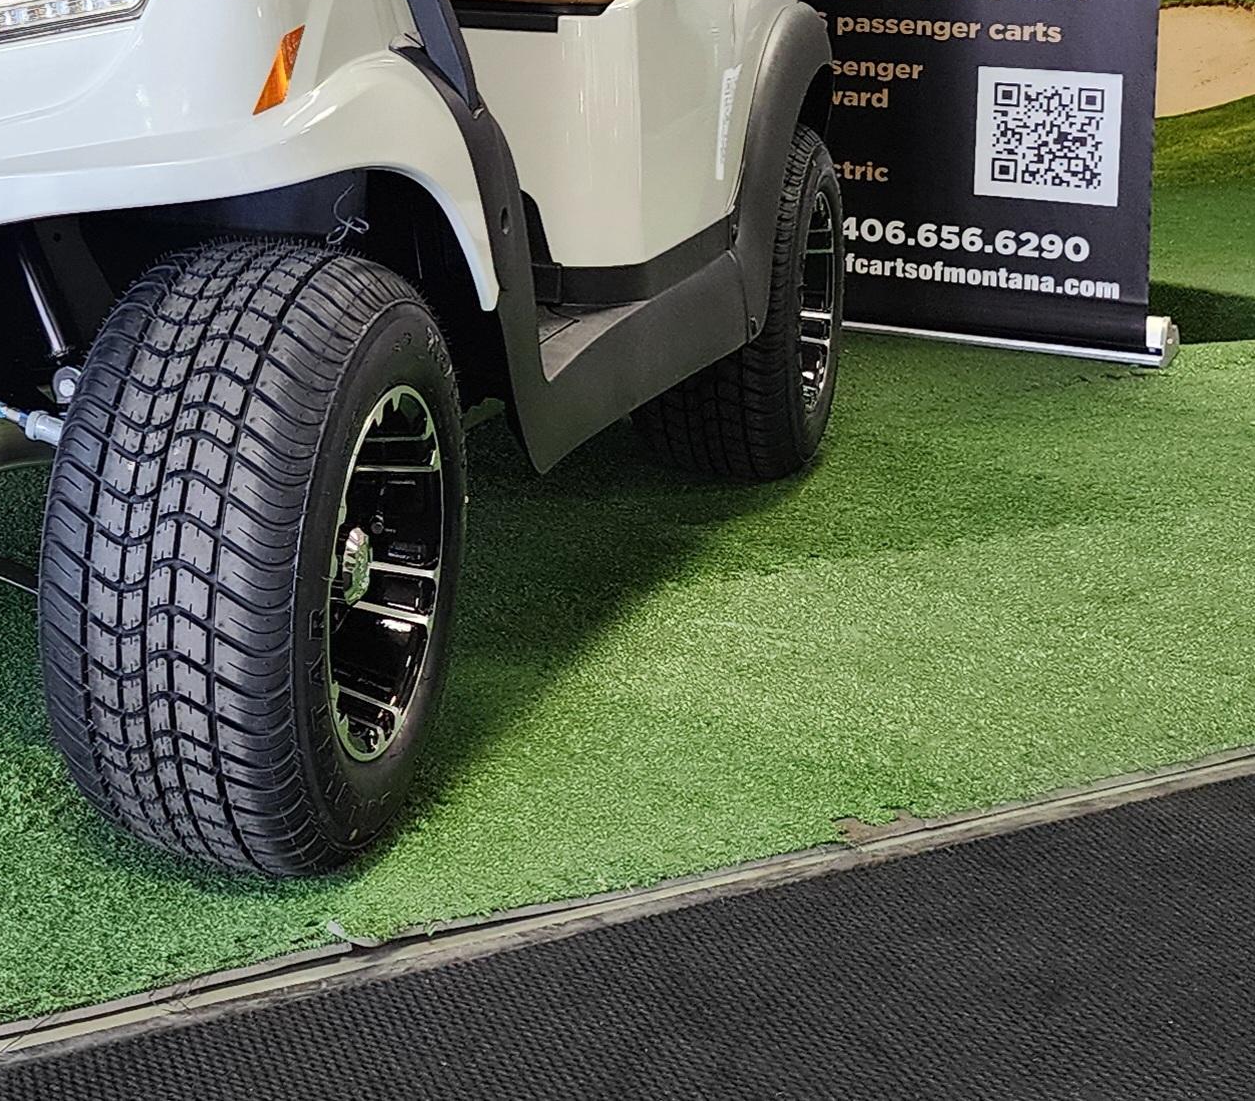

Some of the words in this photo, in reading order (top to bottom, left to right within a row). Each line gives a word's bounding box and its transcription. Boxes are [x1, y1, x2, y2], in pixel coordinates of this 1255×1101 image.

[836, 14, 982, 41] passenger
[988, 21, 1063, 43] carts
[832, 59, 924, 82] senger
[842, 216, 1091, 262] 406.656.6290
